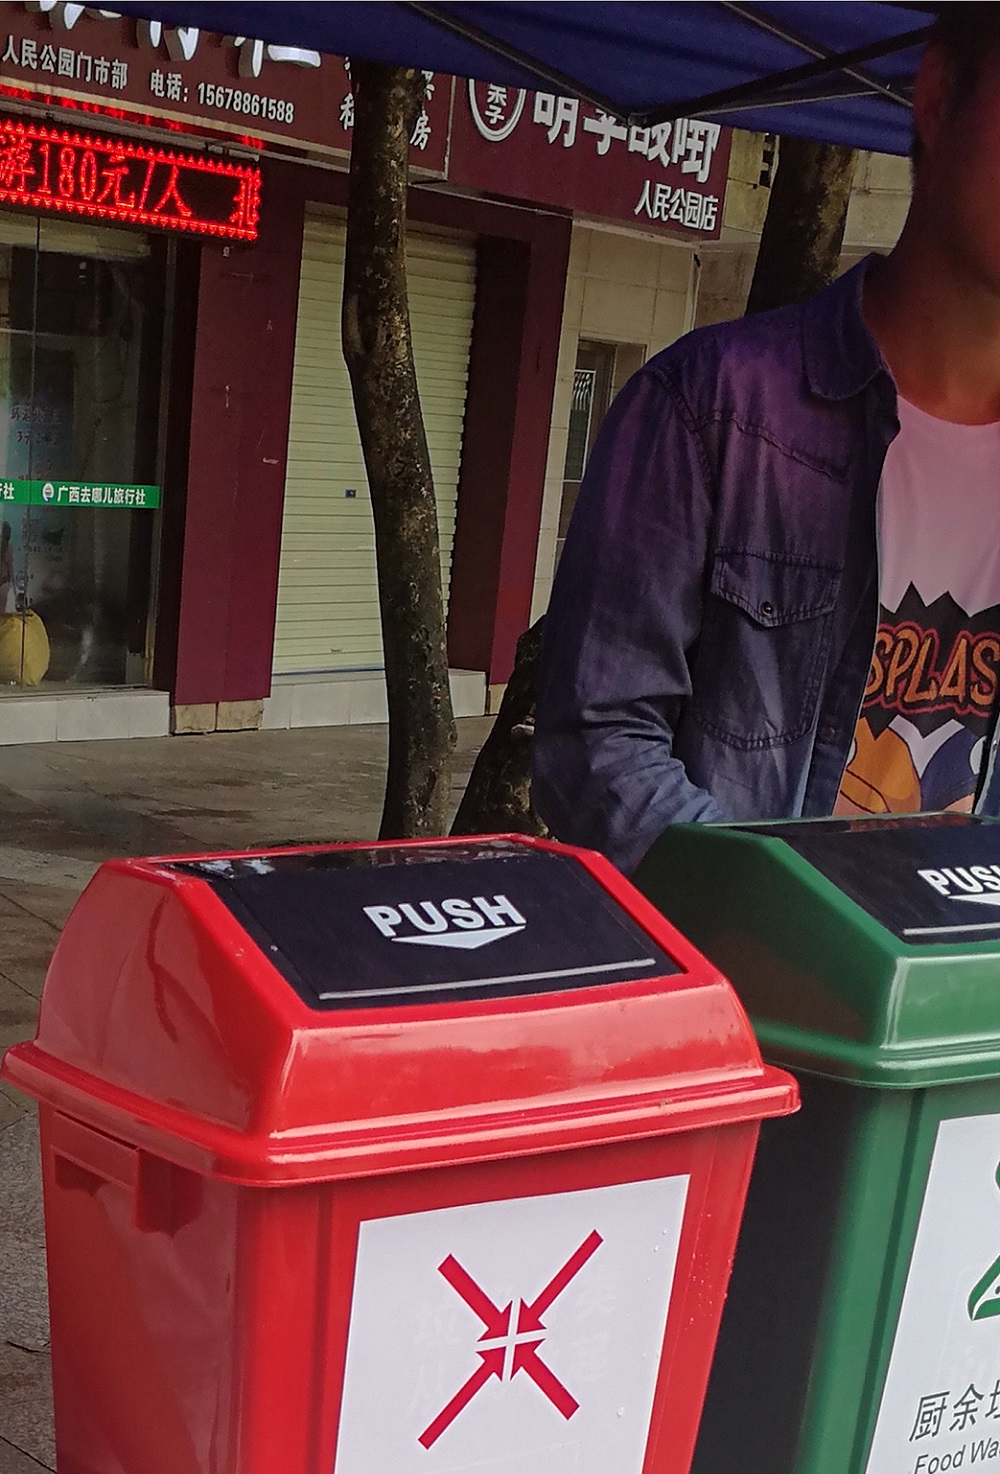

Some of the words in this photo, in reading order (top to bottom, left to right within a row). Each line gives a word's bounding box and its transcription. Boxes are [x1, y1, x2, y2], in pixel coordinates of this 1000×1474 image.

[2, 34, 129, 90] 人民公园门市部
[634, 180, 719, 231] 人民公园店
[56, 484, 147, 506] 广西去哪儿旅行社
[362, 894, 526, 938] PUSH
[971, 1437, 1000, 1464] Wa
